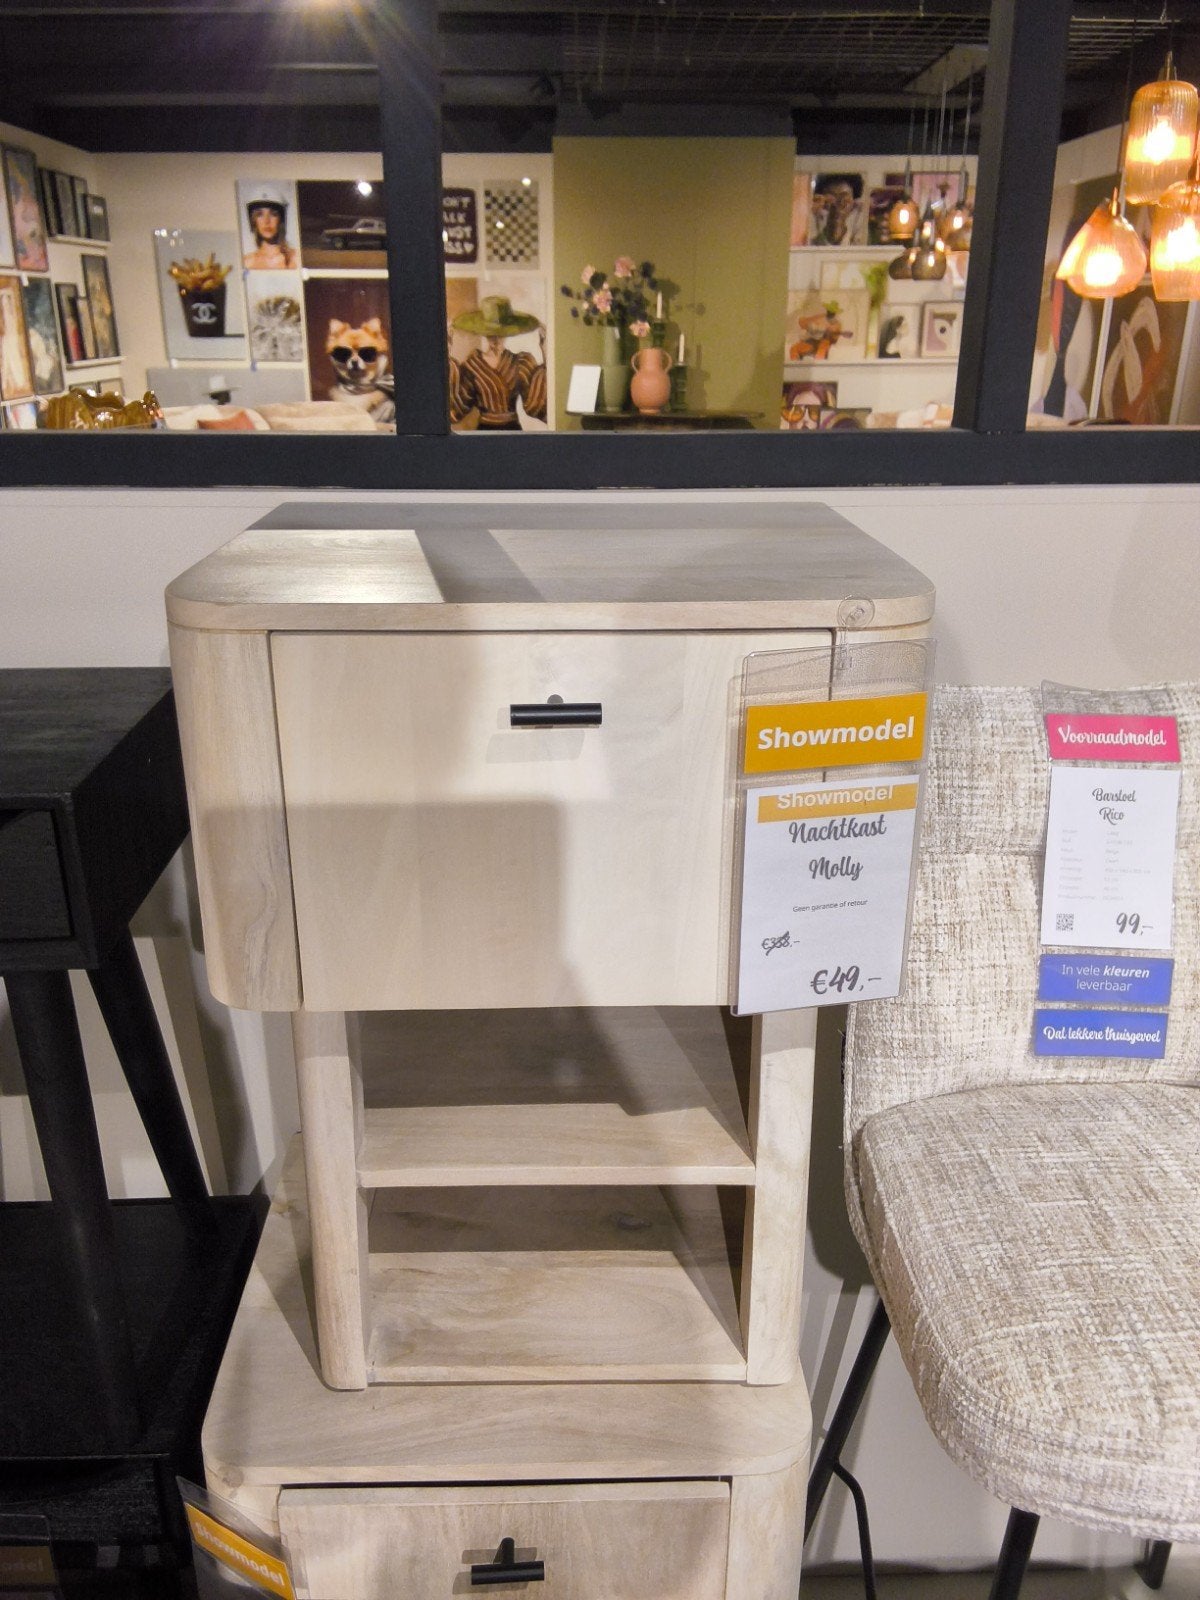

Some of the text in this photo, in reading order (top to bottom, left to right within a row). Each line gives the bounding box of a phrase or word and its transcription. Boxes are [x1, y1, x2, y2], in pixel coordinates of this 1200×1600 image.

[757, 716, 915, 750] Showmodel
[1058, 725, 1167, 746] Voorraadmodel
[777, 784, 893, 809] Showmodel
[1092, 787, 1136, 802] Barstoel
[1099, 806, 1125, 826] Rico
[788, 814, 887, 844] Nachtkast
[808, 855, 863, 881] Molly
[792, 904, 810, 912] Geen
[839, 900, 848, 908] of
[847, 899, 868, 908] retour
[1061, 964, 1150, 979] In vele kleuren
[1076, 979, 1133, 992] leverbaar
[1043, 1025, 1161, 1045] Dat lekkere thuisgevoel
